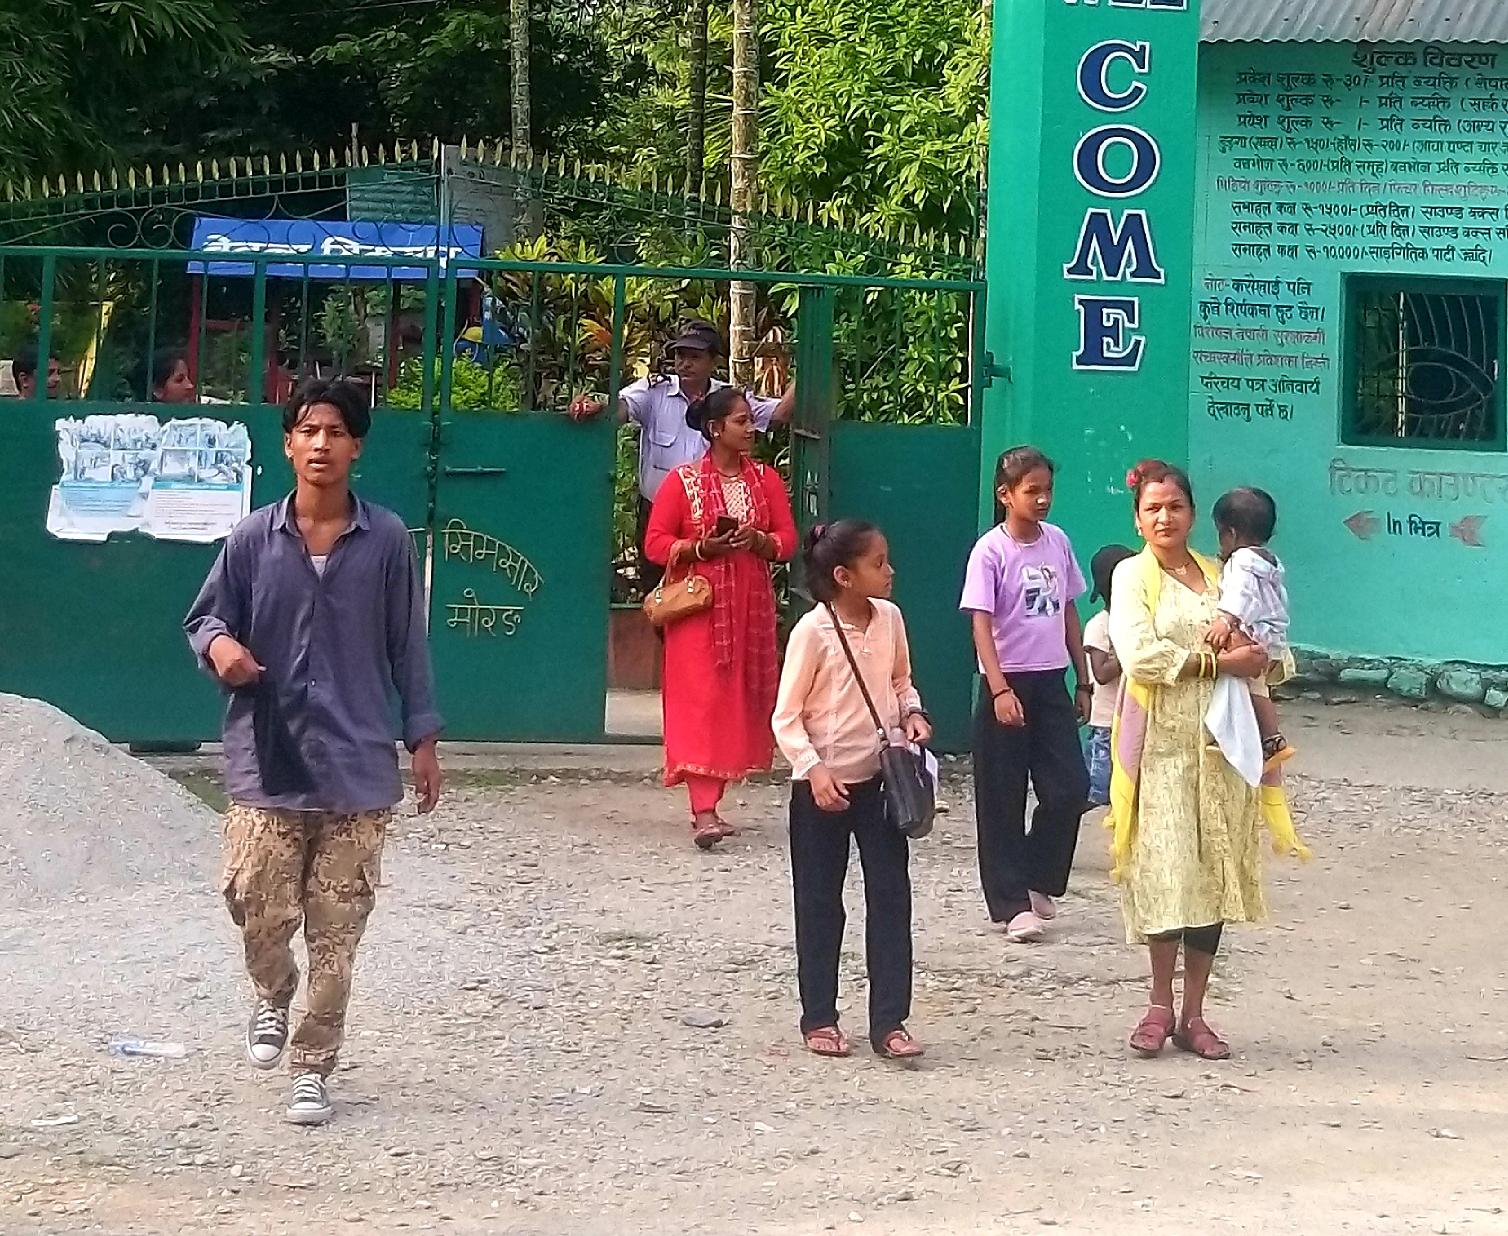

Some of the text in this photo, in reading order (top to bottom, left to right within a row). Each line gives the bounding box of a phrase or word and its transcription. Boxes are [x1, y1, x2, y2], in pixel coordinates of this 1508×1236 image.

[1423, 46, 1498, 70] विवरण
[1386, 511, 1403, 536] In
[440, 518, 545, 602] सिमसार
[445, 587, 525, 638] मोरङ
